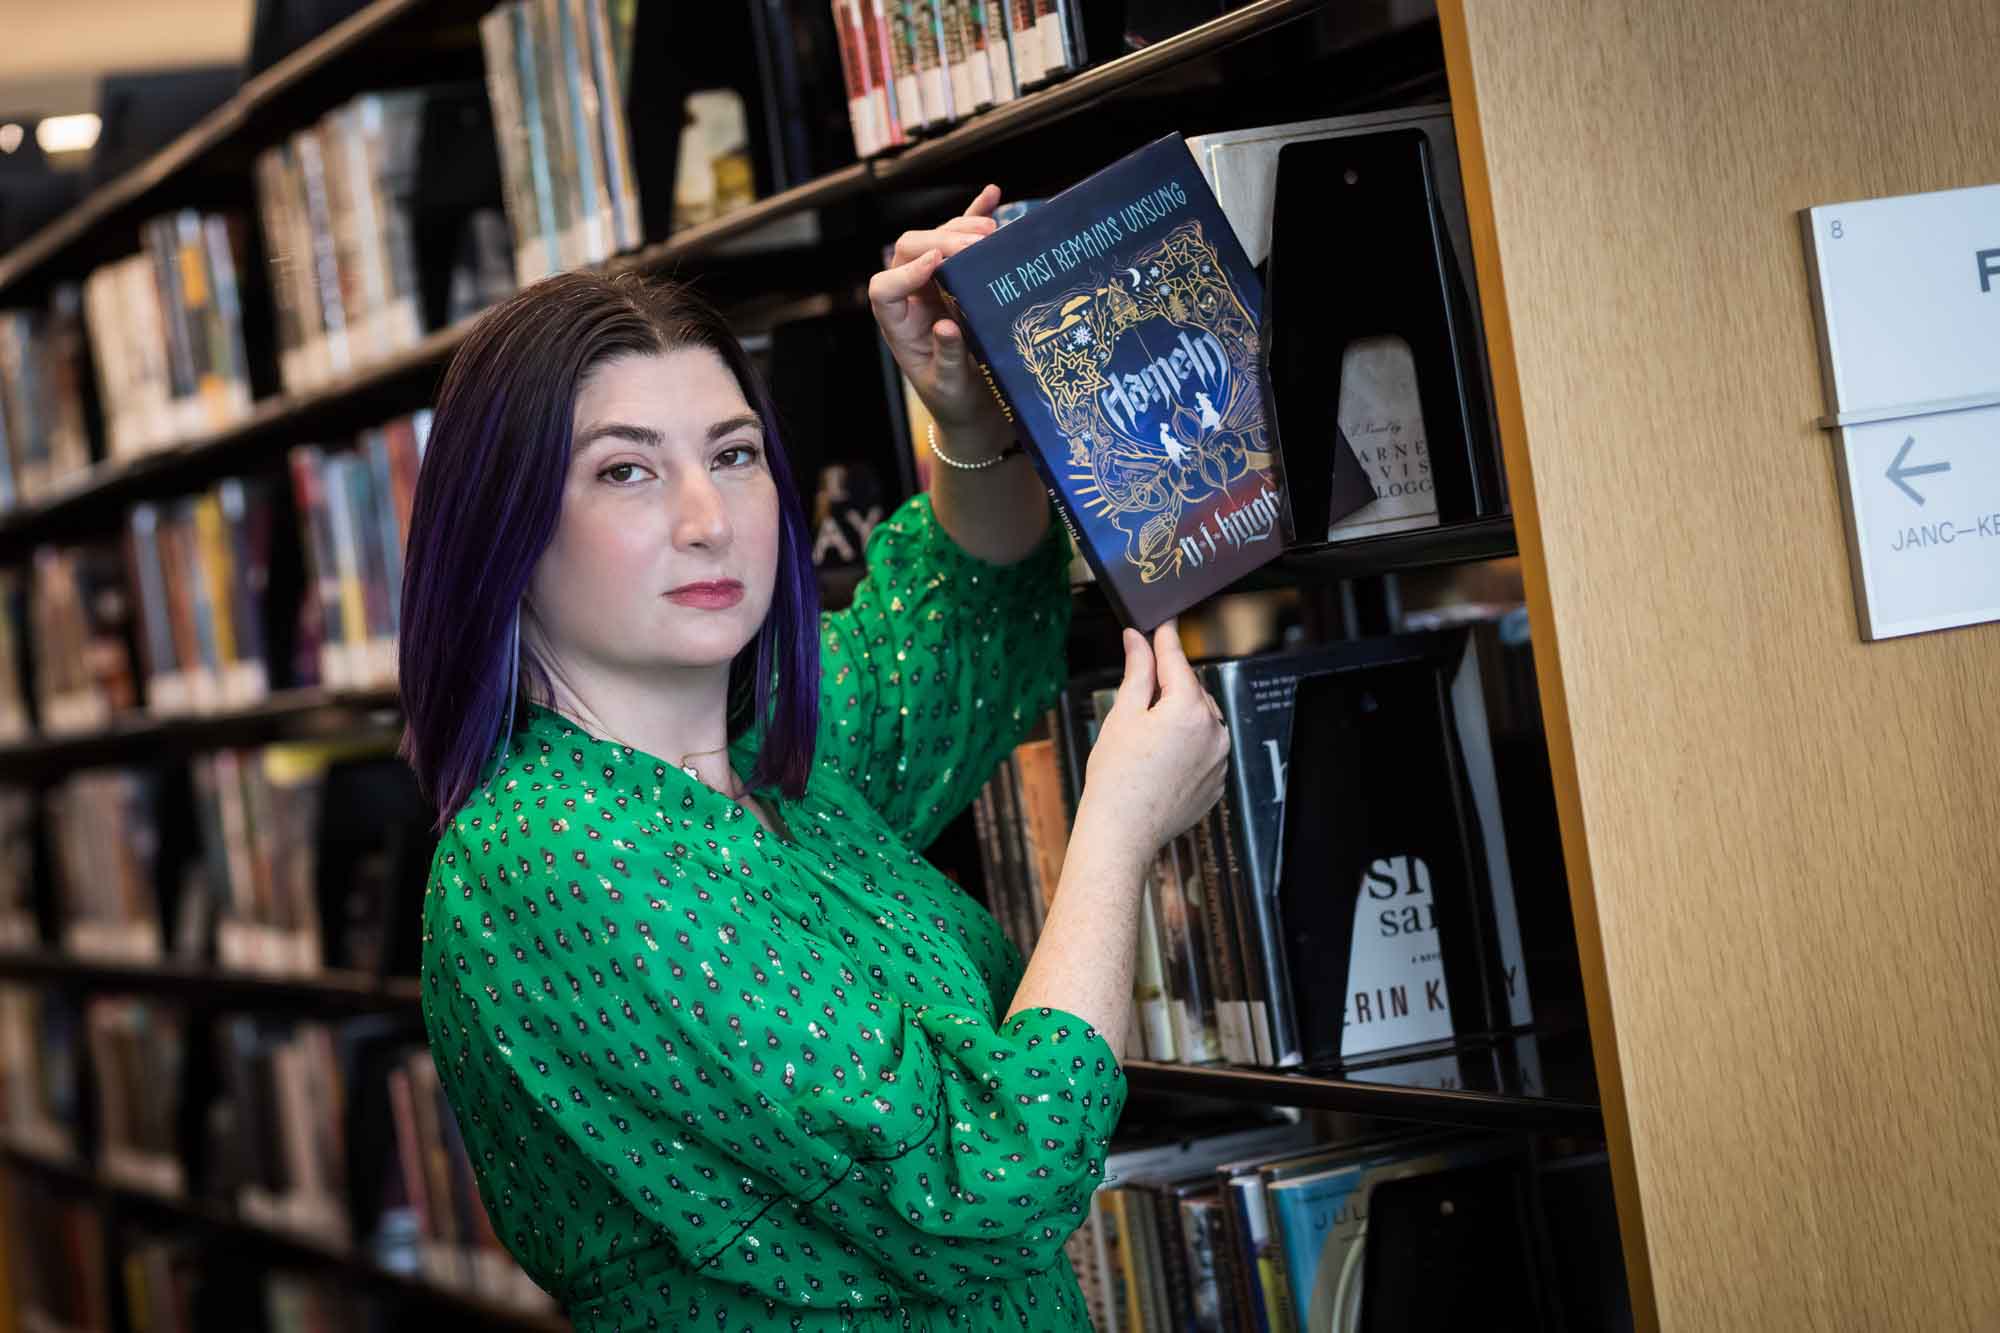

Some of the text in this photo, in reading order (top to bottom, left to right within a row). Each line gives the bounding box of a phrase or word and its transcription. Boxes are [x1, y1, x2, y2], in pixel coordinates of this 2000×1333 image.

[986, 181, 1187, 307] THE PAST REMAINS UNSUNG
[1831, 219, 1844, 239] 8
[1101, 330, 1229, 436] Hameln
[1344, 985, 1409, 1027] RIN
